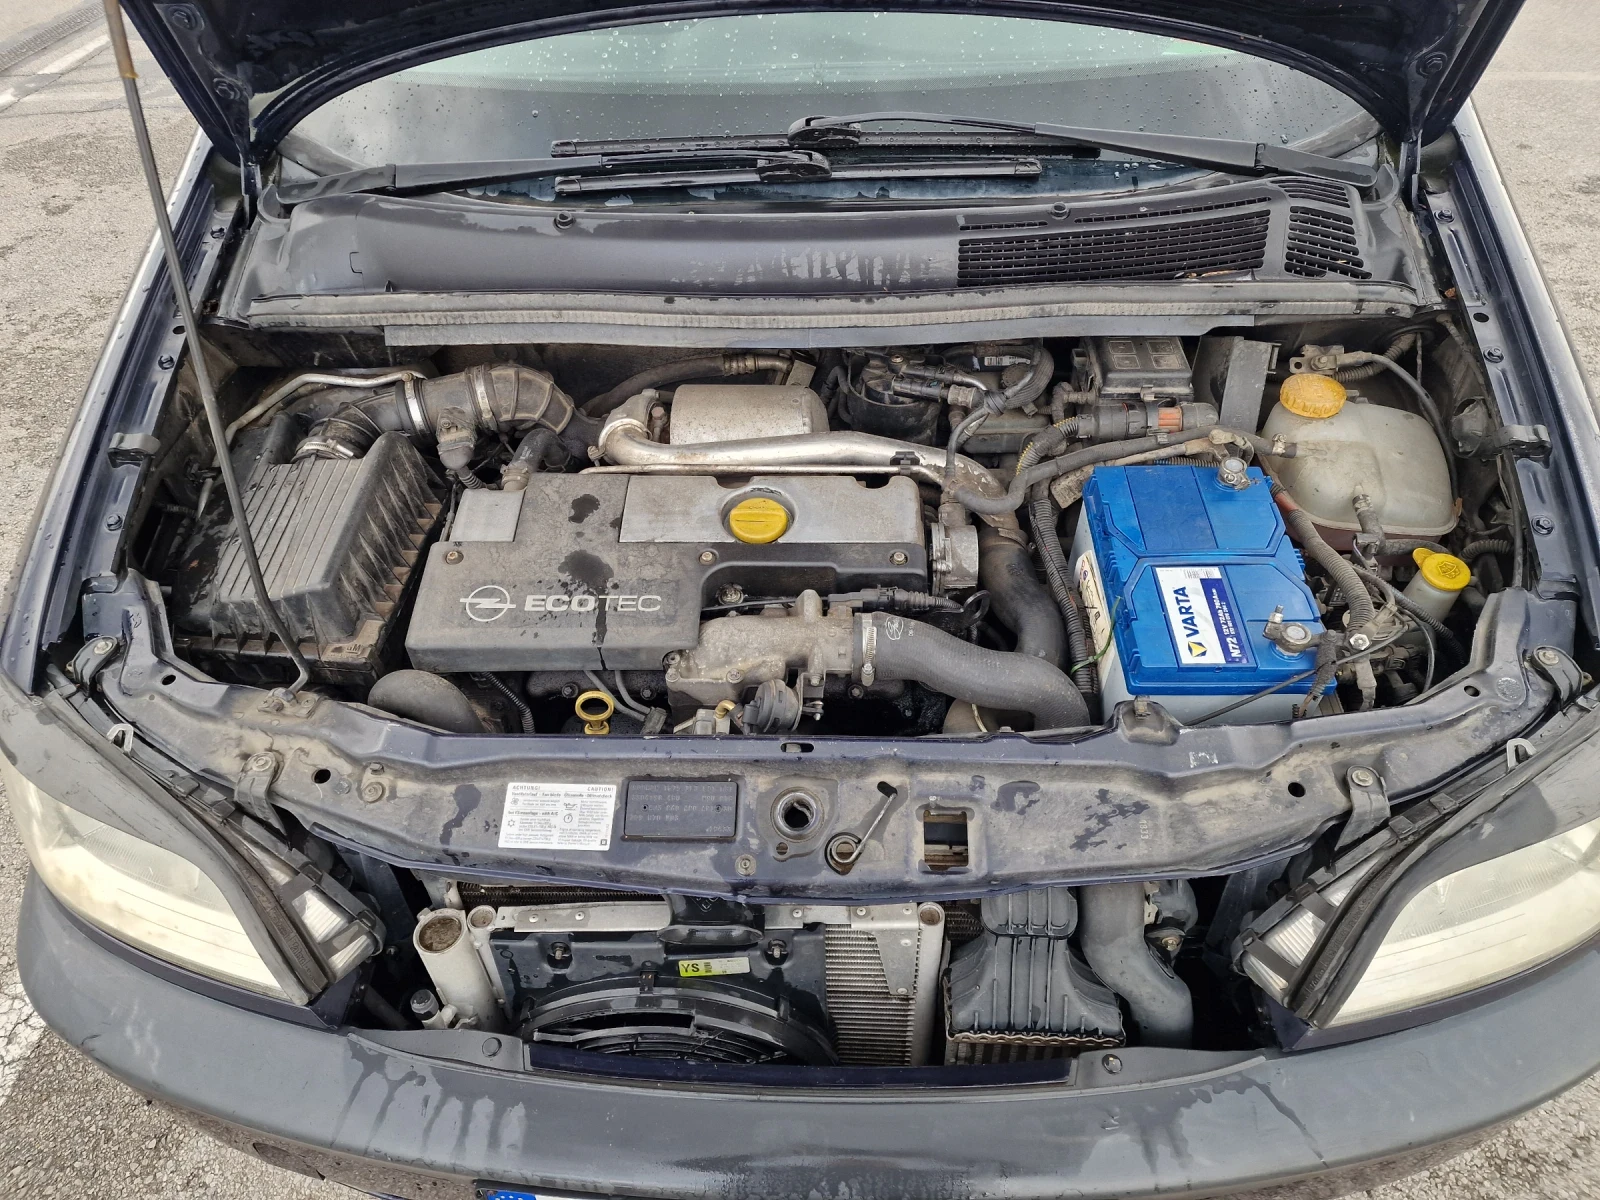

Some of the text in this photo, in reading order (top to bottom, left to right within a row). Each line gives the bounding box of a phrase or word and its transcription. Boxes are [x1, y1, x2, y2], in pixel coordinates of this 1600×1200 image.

[524, 594, 661, 612] ECOTEC
[1173, 586, 1199, 638] VARTA
[1226, 637, 1242, 657] N72
[681, 963, 699, 973] YS
